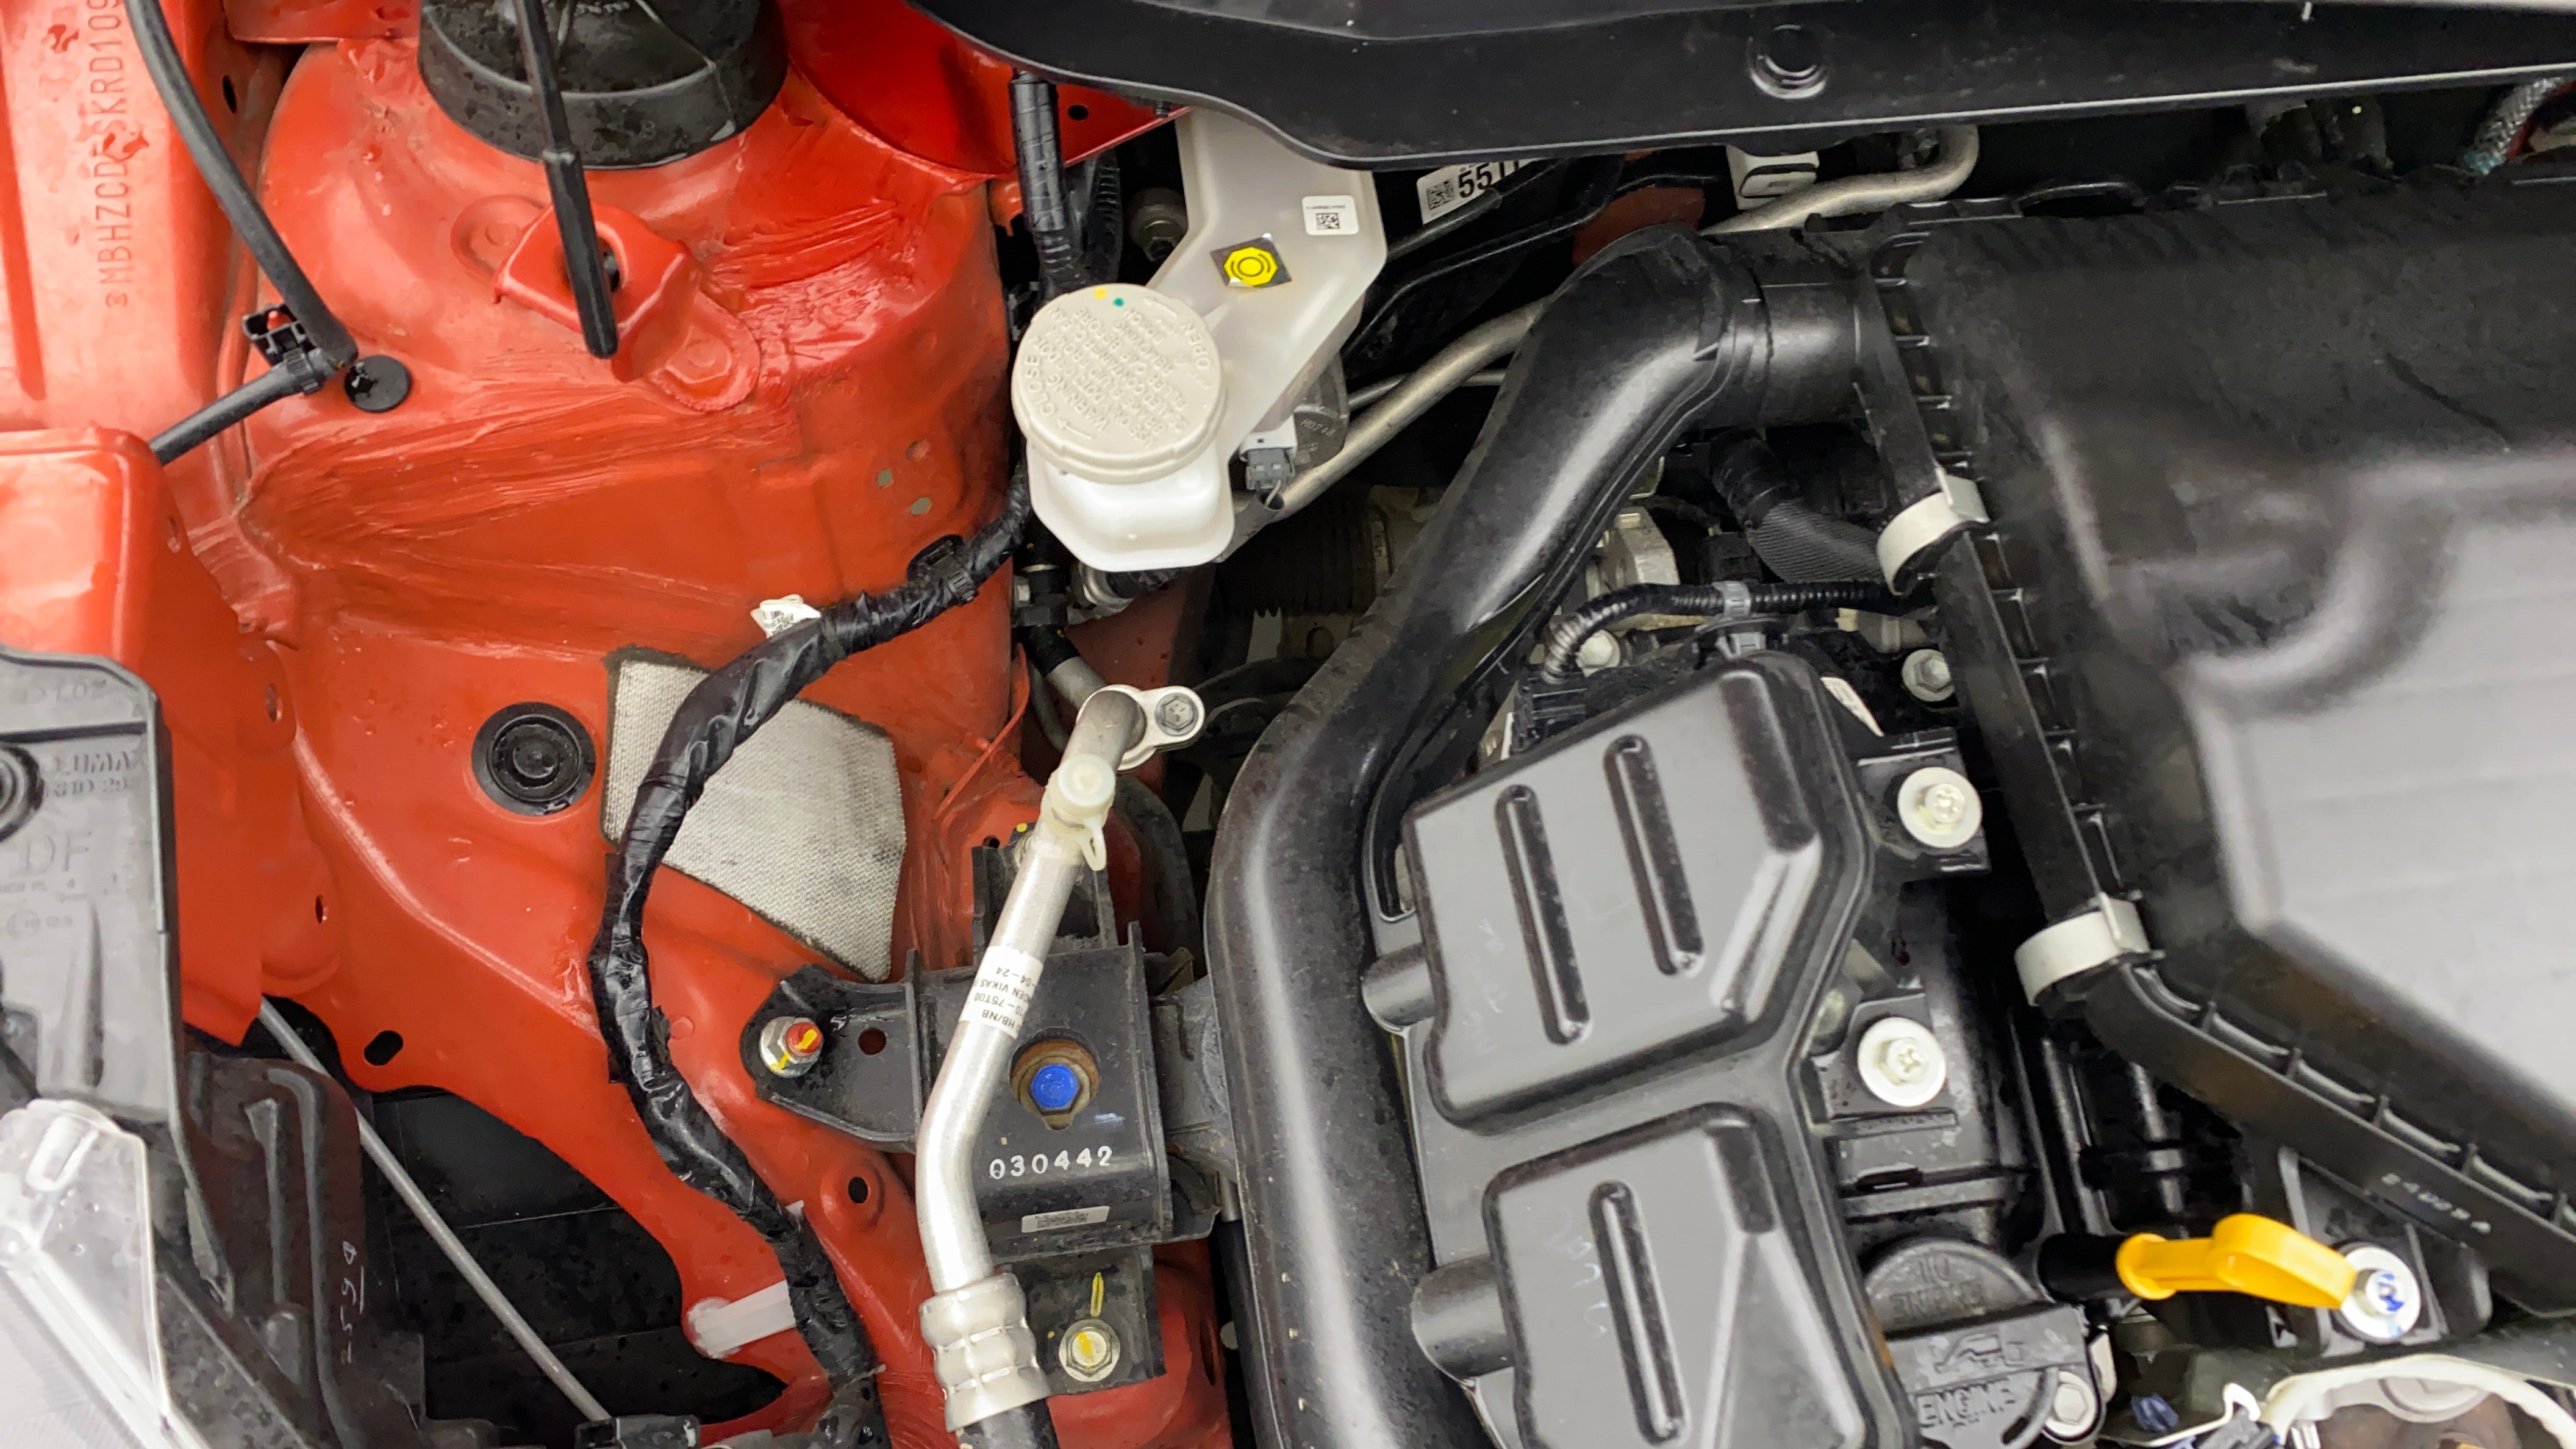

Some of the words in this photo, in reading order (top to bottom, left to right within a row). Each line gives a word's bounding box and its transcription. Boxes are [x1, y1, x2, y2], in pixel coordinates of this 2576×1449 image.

[1122, 307, 1166, 348] BOSCH
[1179, 321, 1212, 371] OPEN
[1024, 354, 1057, 417] CLOSE
[1044, 371, 1108, 432] WARNING
[980, 978, 1009, 992] VIKAS
[982, 1009, 1016, 1029] HB/NB
[988, 1145, 1114, 1180] 030442
